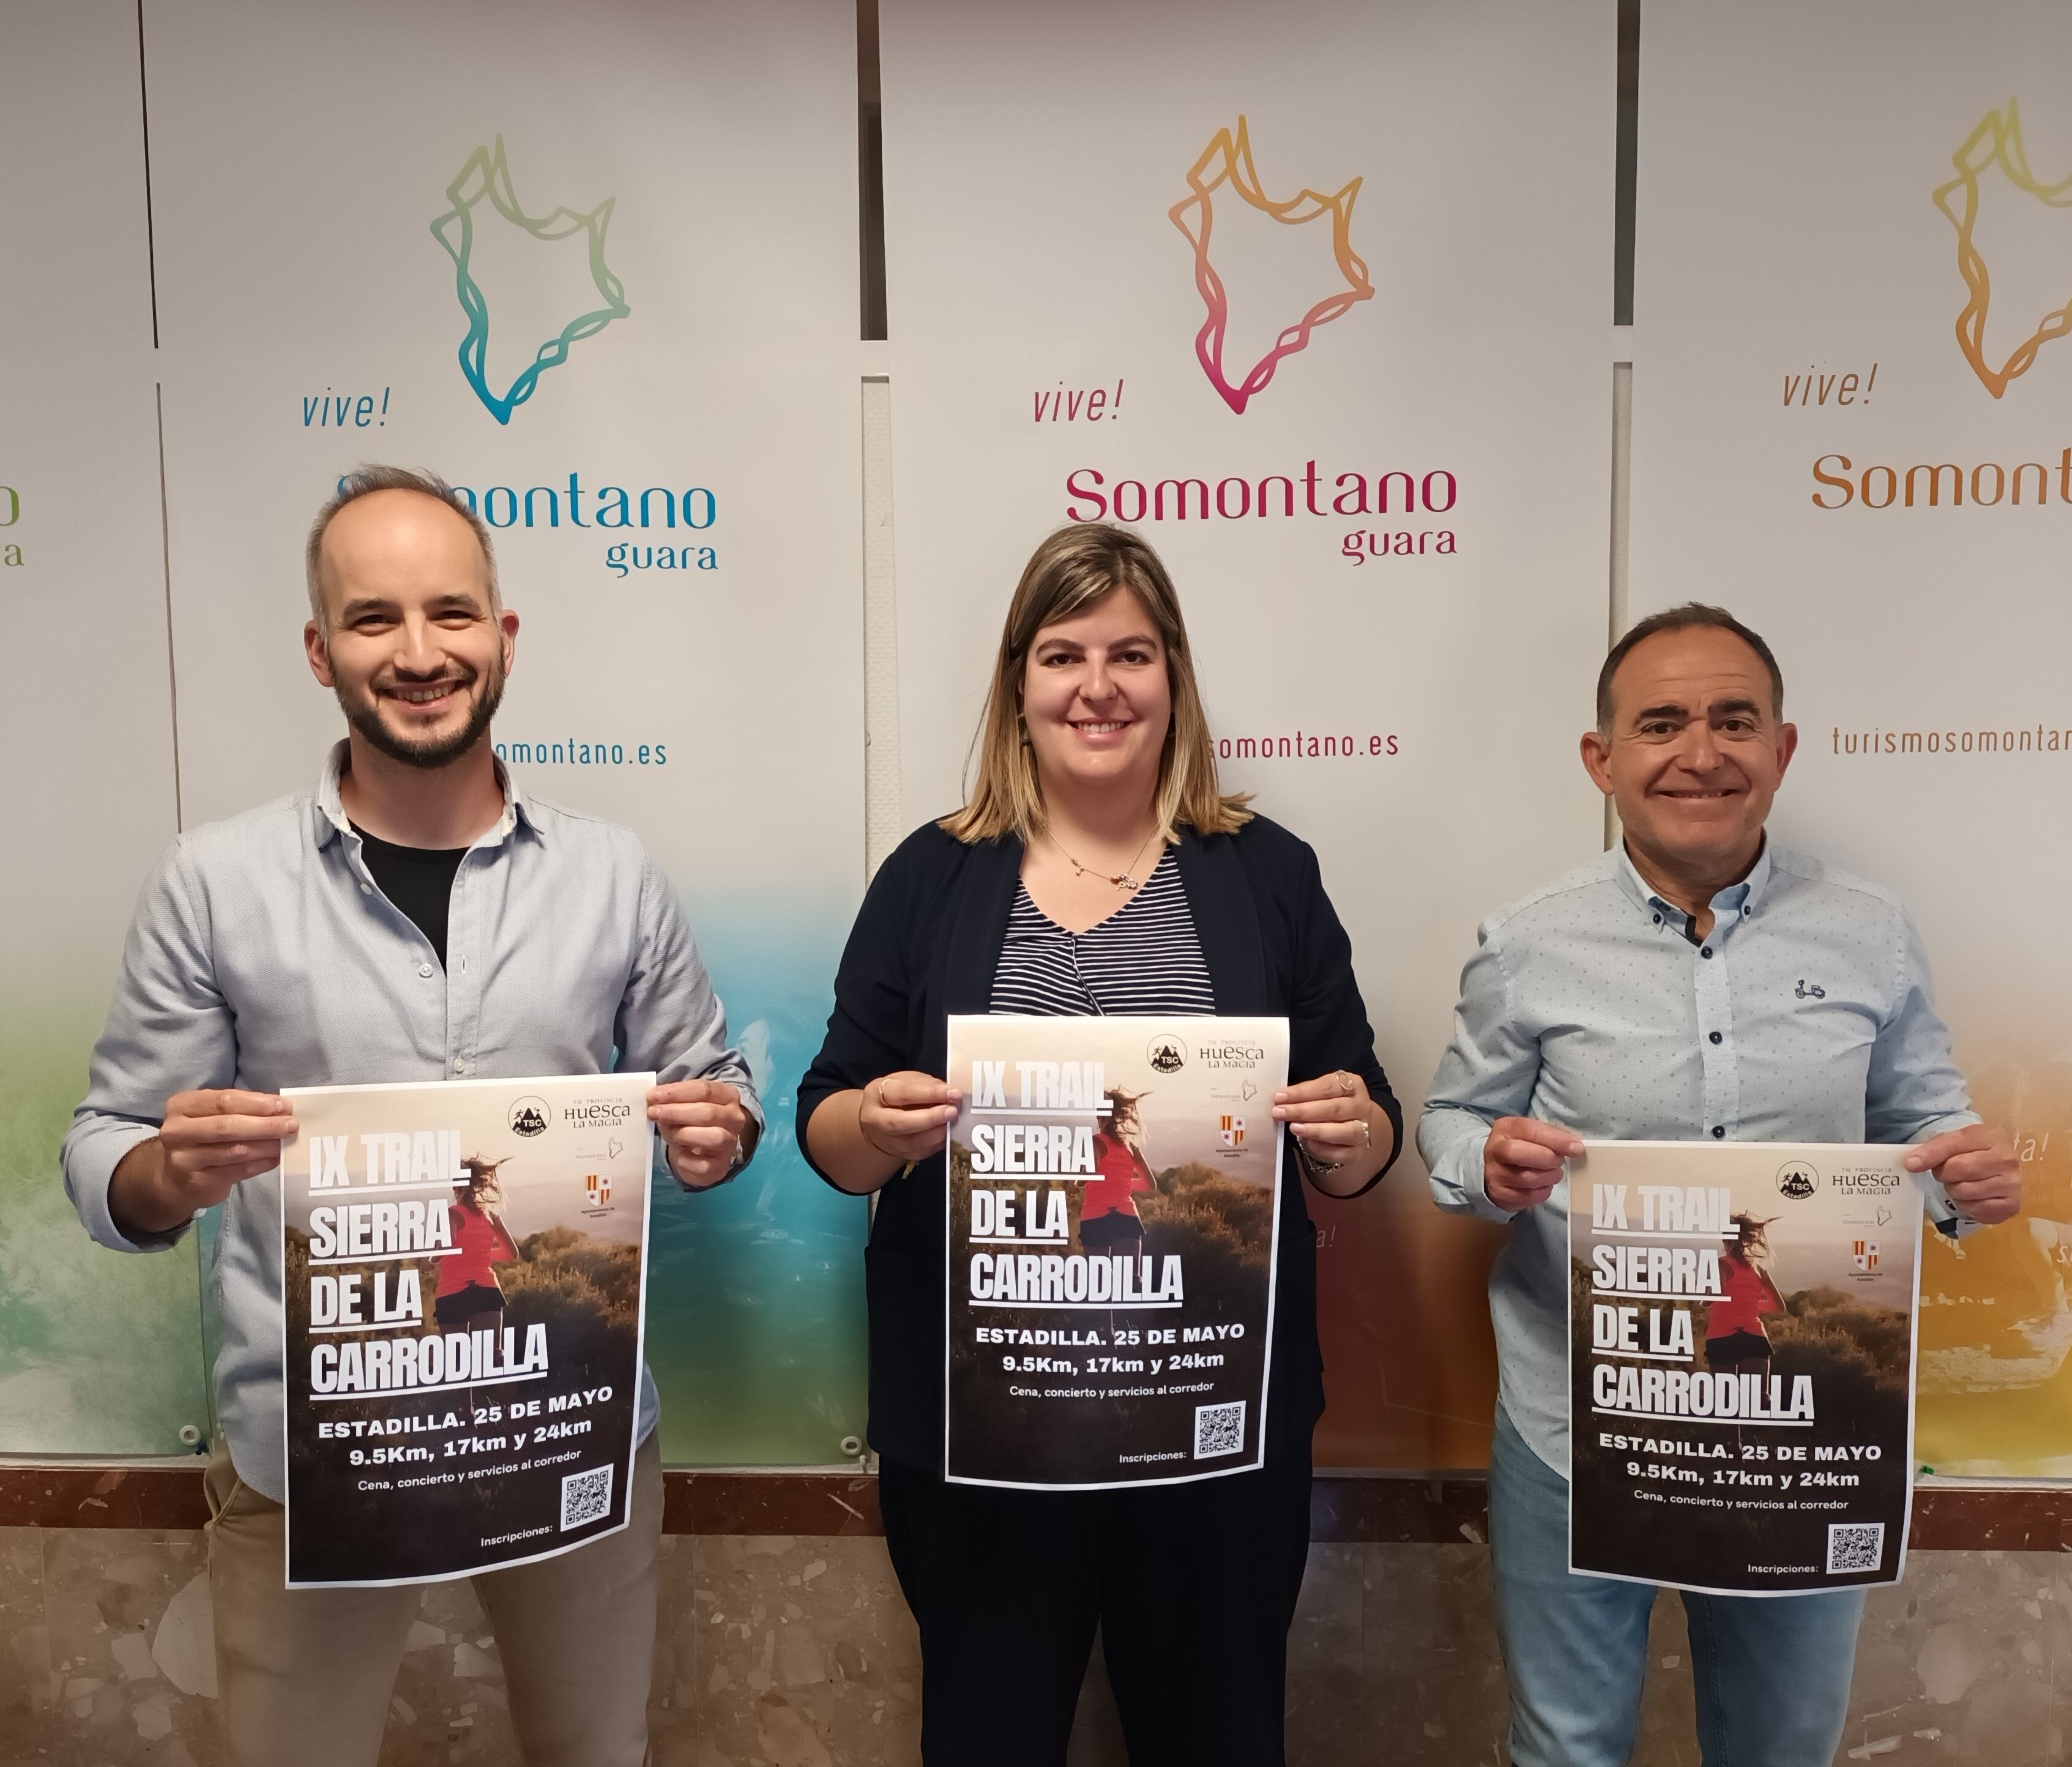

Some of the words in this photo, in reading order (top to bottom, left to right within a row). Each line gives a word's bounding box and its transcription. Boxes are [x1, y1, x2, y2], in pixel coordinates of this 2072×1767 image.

[1034, 379, 1124, 422] vive!
[1783, 363, 1878, 406] vive!
[304, 387, 390, 427] vive!
[1066, 459, 1457, 523] Somontano
[606, 543, 718, 578] guara
[1341, 530, 1458, 566] guara
[496, 738, 666, 765] omontano.es
[972, 1060, 1006, 1107] IX
[1016, 1061, 1113, 1108] TRAIL
[523, 1118, 542, 1127] TSC
[310, 1135, 349, 1188] IX
[360, 1129, 471, 1184] TRAIL
[971, 1125, 1095, 1173] SIERRA
[309, 1199, 452, 1257] SIERRA
[972, 1190, 1015, 1237] DE
[1026, 1191, 1069, 1237] LA
[1593, 1183, 1628, 1229] IX
[1638, 1185, 1740, 1232] TRAIL
[971, 1253, 1183, 1301] CARRODILLA
[1592, 1244, 1721, 1294] SIERRA
[311, 1274, 362, 1325] DE
[374, 1269, 422, 1322] LA
[976, 1328, 1106, 1345] ESTADILLA.
[1114, 1331, 1139, 1345] 25
[1147, 1329, 1176, 1344] DE
[1183, 1323, 1245, 1342] MAYO
[1593, 1304, 1639, 1351] DE
[1649, 1308, 1694, 1354] LA
[311, 1323, 548, 1393] CARRODILLA
[1003, 1356, 1078, 1375] 9.5Km,
[1087, 1358, 1143, 1372] 17km
[1150, 1360, 1163, 1375] y
[1169, 1353, 1223, 1370] 24km
[319, 1412, 465, 1438] ESTADILLA.
[474, 1407, 501, 1424] 25
[510, 1401, 540, 1419] DE
[549, 1386, 613, 1413] MAYO
[1010, 1386, 1042, 1398] Cena,
[1045, 1388, 1096, 1397] concierto
[1100, 1389, 1105, 1399] y
[1108, 1386, 1155, 1397] servicios
[1157, 1385, 1166, 1394] al
[1169, 1382, 1215, 1394] corredor
[1593, 1364, 1814, 1419] CARRODILLA
[350, 1446, 434, 1466] 9.5Km,
[444, 1436, 506, 1457] 17km
[514, 1434, 527, 1450] y
[534, 1419, 591, 1442] 24km
[1119, 1451, 1187, 1463] Inscripciones:
[1600, 1433, 1734, 1459] ESTADILLA.
[1742, 1446, 1768, 1460] 25
[1777, 1446, 1806, 1460] DE
[1814, 1446, 1882, 1461] MAYO
[358, 1479, 393, 1491] Cena,
[398, 1472, 455, 1488] concierto
[458, 1473, 465, 1483] y
[468, 1462, 518, 1480] servicios
[521, 1460, 531, 1470] al
[534, 1450, 581, 1467] corredor
[1627, 1462, 1704, 1486] 9.5Km,
[1713, 1471, 1773, 1486] 17km
[1780, 1475, 1793, 1490] y
[1800, 1472, 1859, 1487] 24km
[1634, 1490, 1667, 1503] Cena,
[1670, 1495, 1723, 1507] concierto
[1726, 1500, 1733, 1509] y
[1735, 1500, 1784, 1509] servicios
[1787, 1500, 1797, 1509] al
[1800, 1500, 1849, 1509] corredor
[481, 1525, 553, 1547] Inscripciones:
[1748, 1564, 1818, 1575] Inscripciones:
